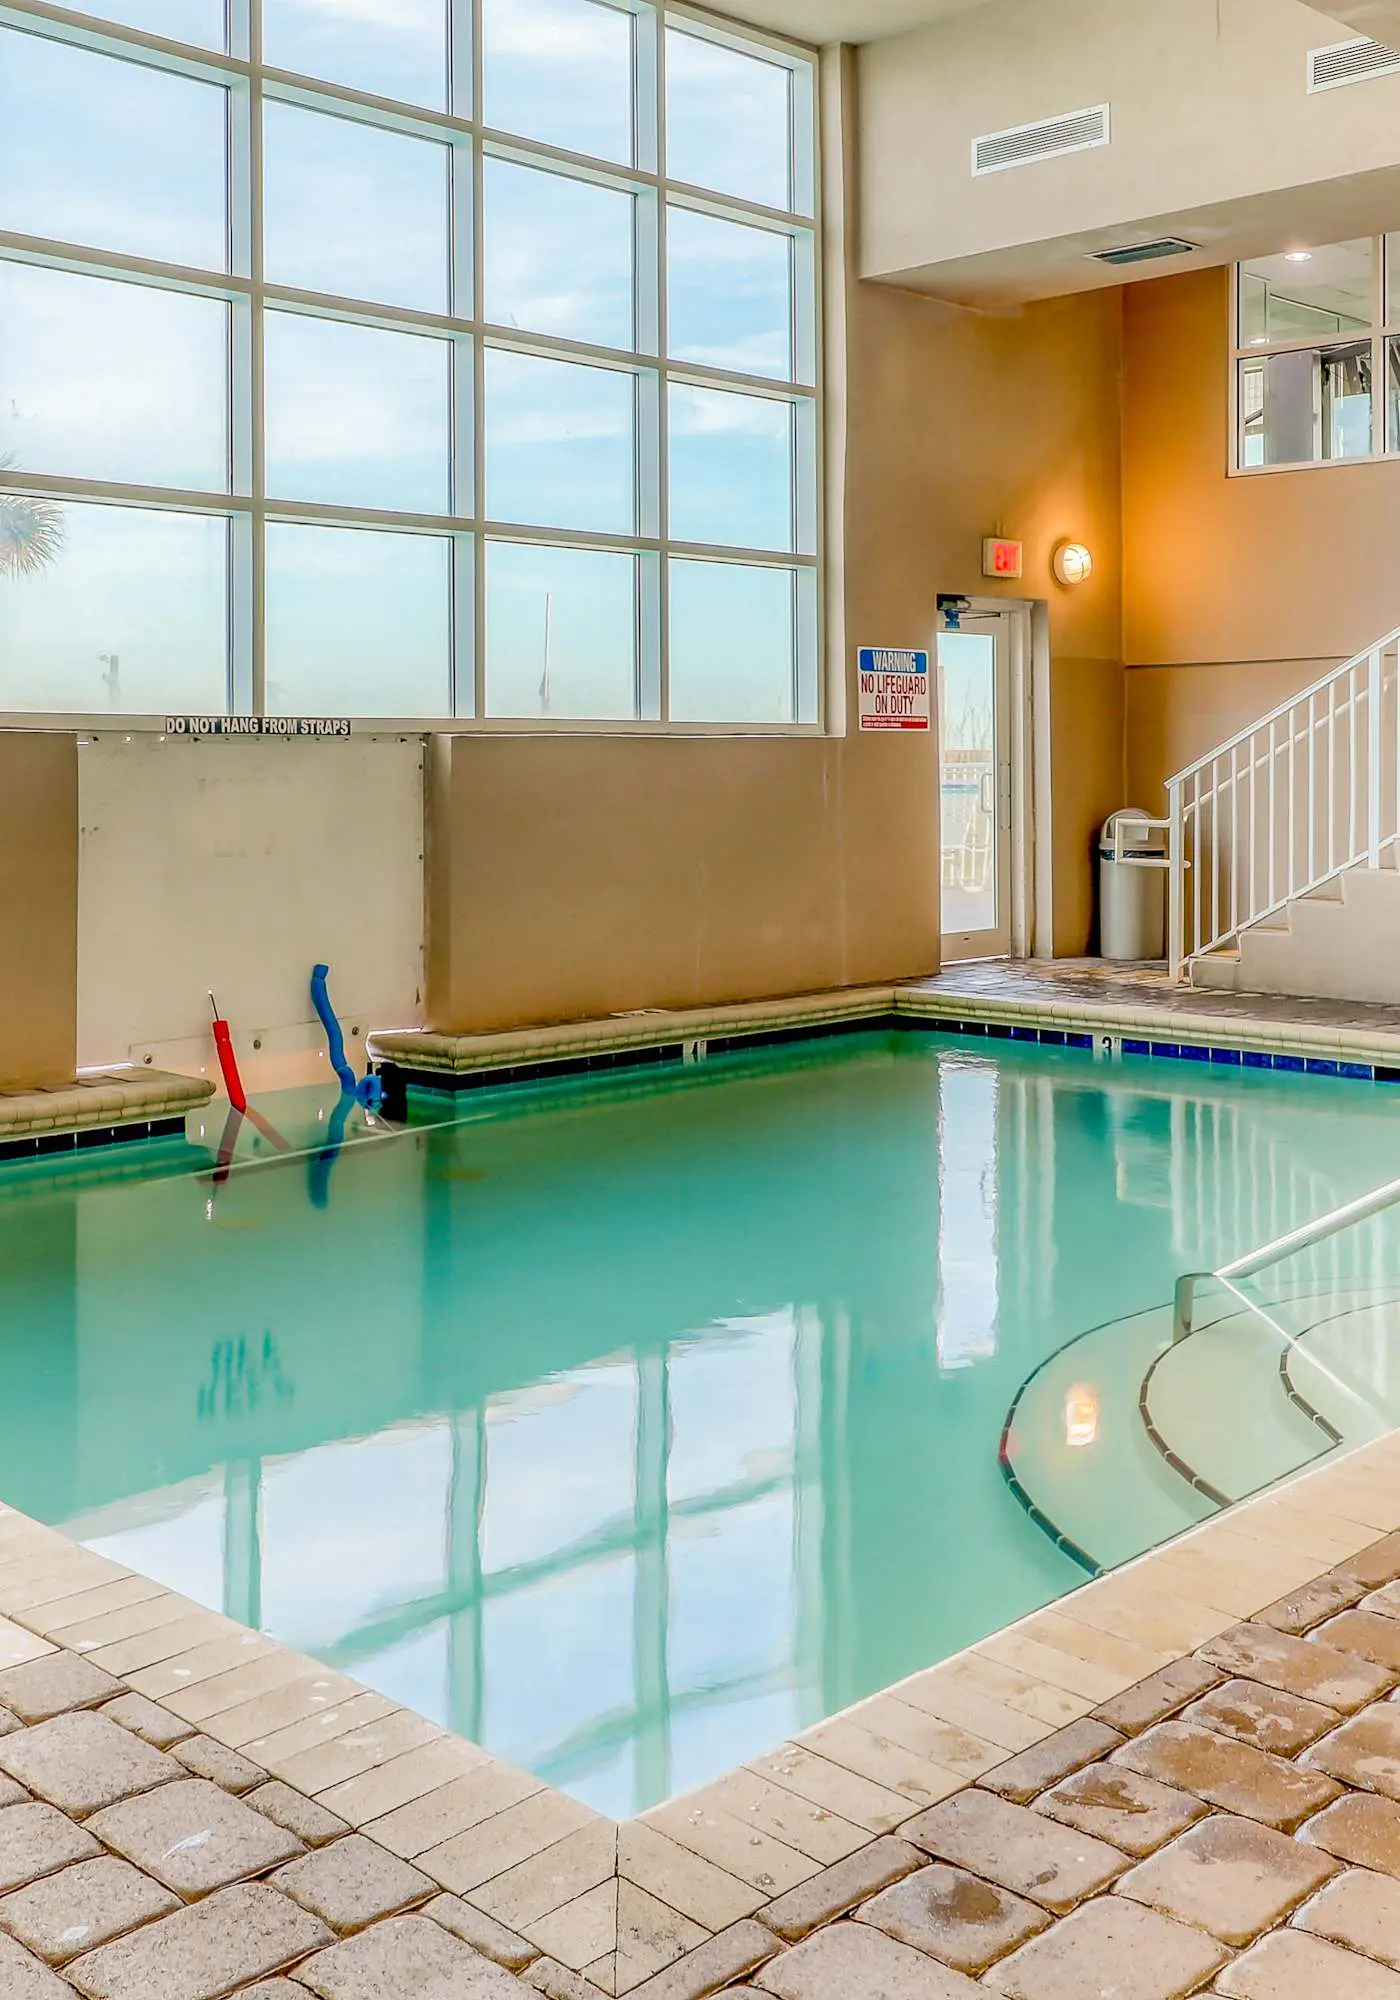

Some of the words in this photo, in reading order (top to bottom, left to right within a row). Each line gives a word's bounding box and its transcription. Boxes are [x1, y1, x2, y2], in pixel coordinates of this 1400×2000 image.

[872, 651, 916, 672] WARNING
[861, 674, 874, 693] NO
[877, 675, 926, 695] LIFEGUARD
[875, 695, 887, 713] ON
[891, 696, 914, 714] DUTY
[166, 718, 186, 733] DO
[189, 718, 218, 733] NOT
[221, 718, 259, 733] HANG
[262, 718, 297, 734] FROM
[300, 719, 349, 734] STRAPS
